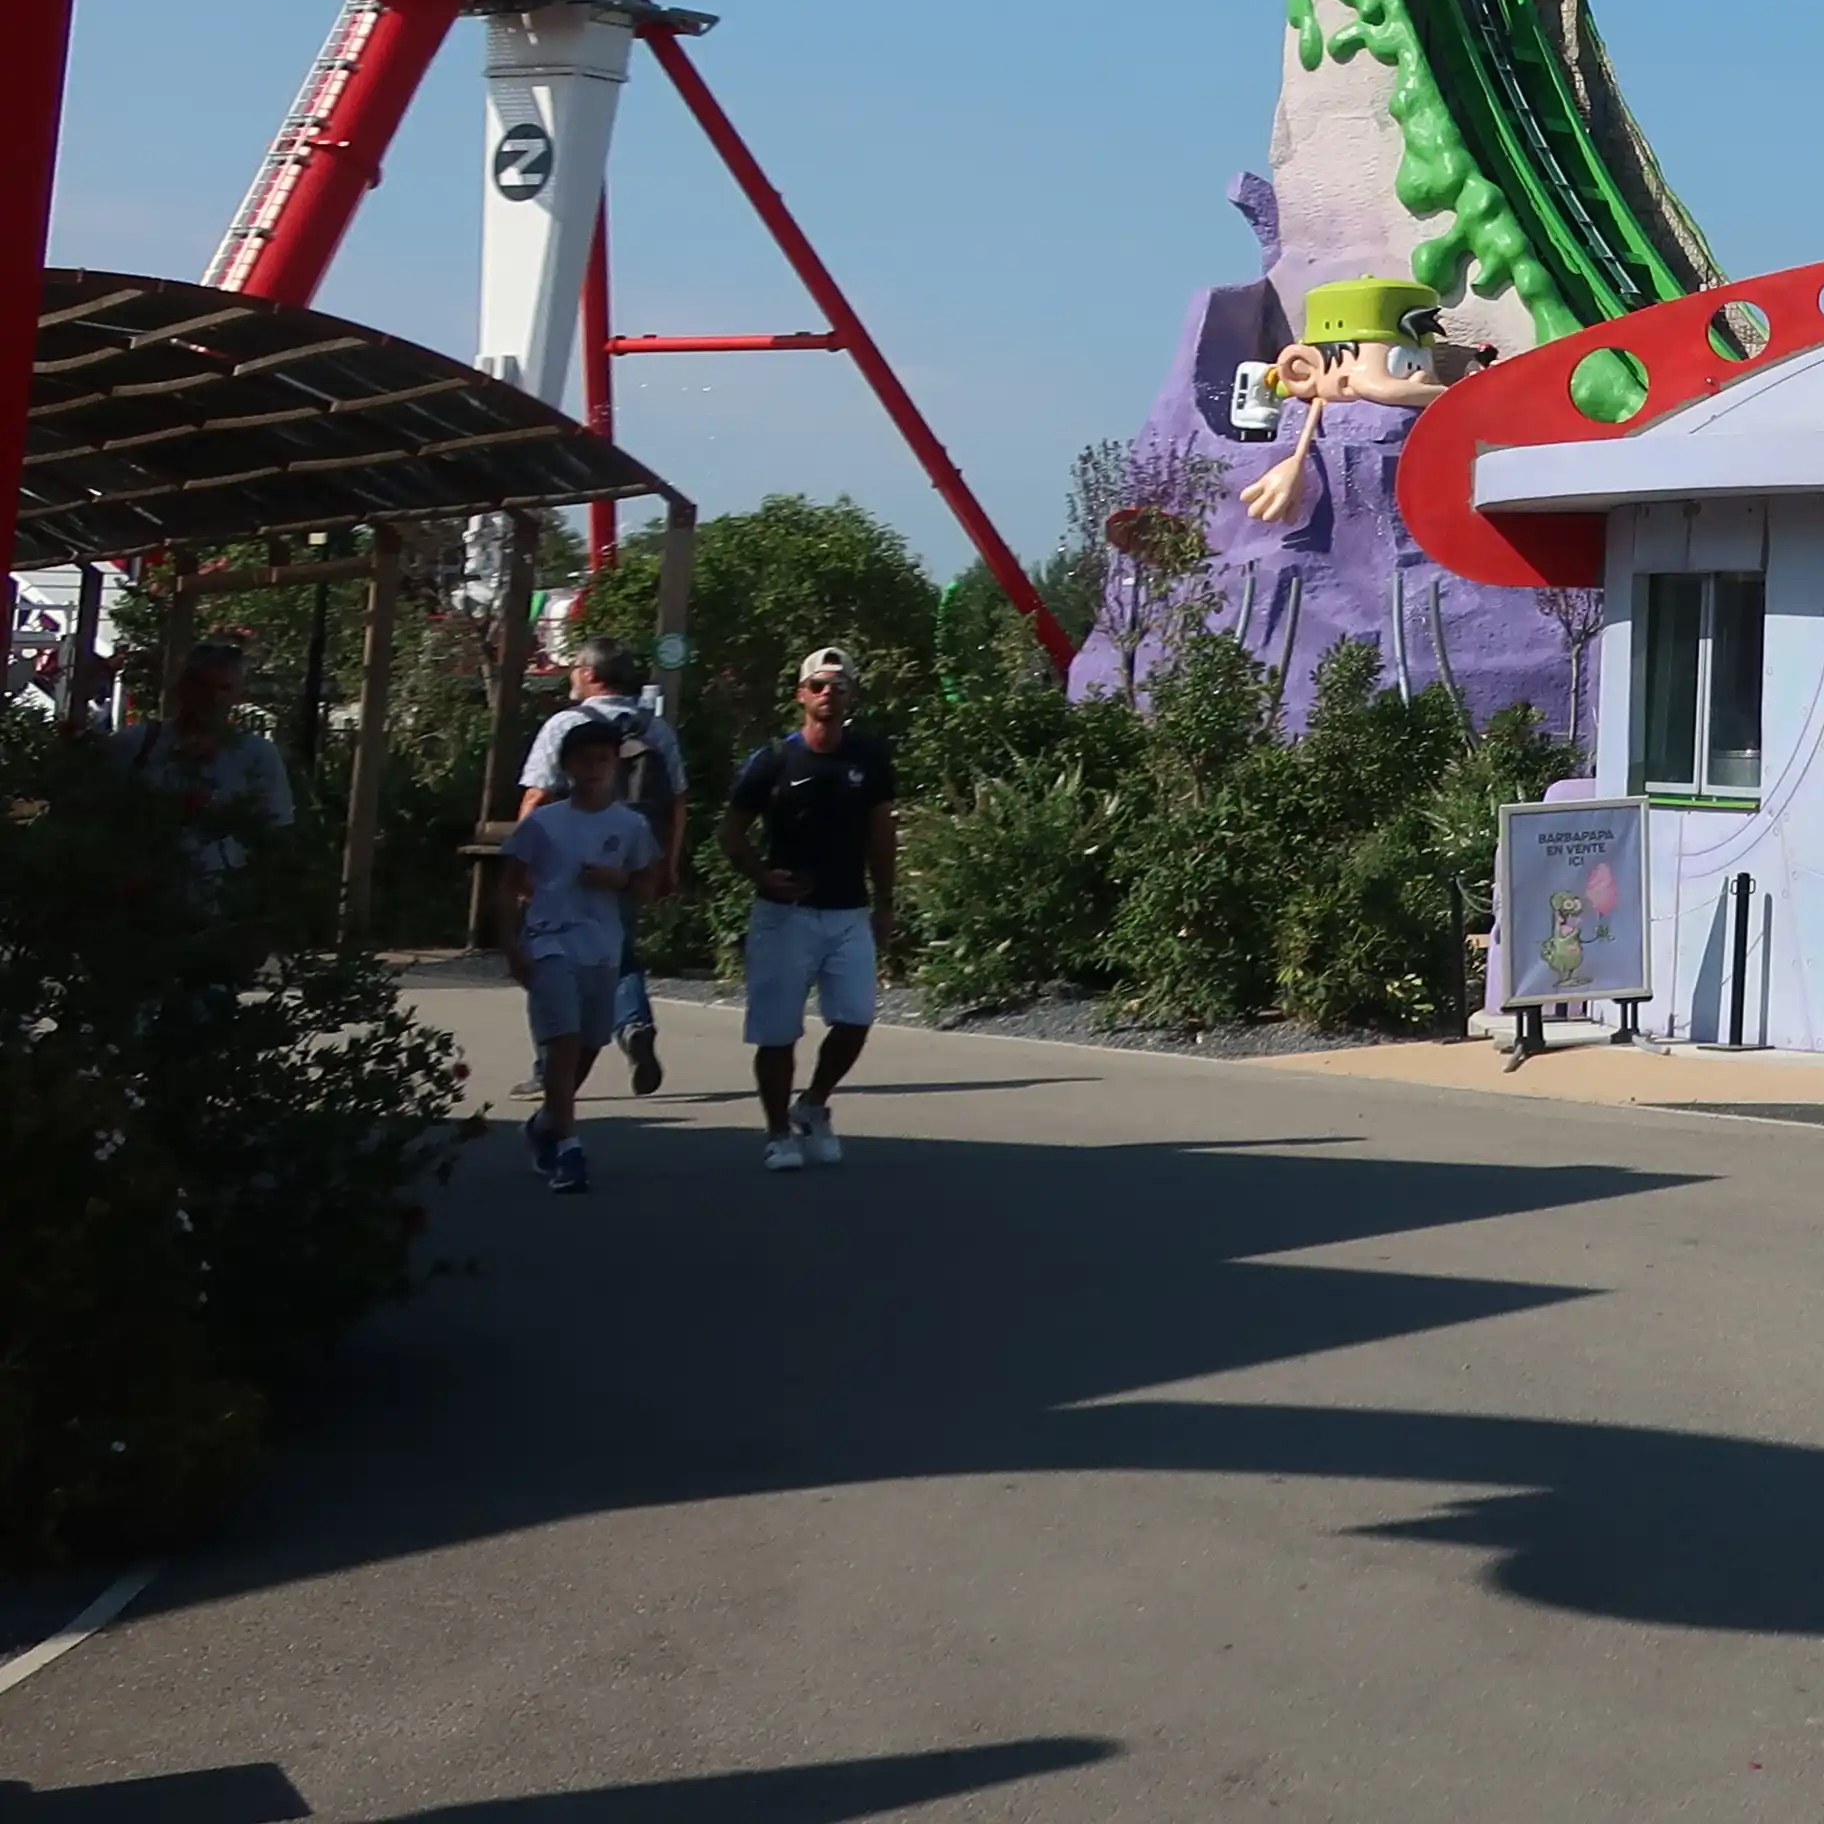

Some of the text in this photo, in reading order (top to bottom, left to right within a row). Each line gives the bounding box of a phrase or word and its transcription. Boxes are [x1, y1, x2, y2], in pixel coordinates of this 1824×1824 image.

[1538, 829, 1615, 844] BARBAPAPA
[1546, 843, 1607, 856] EN VENTE
[1568, 856, 1585, 867] ICI
